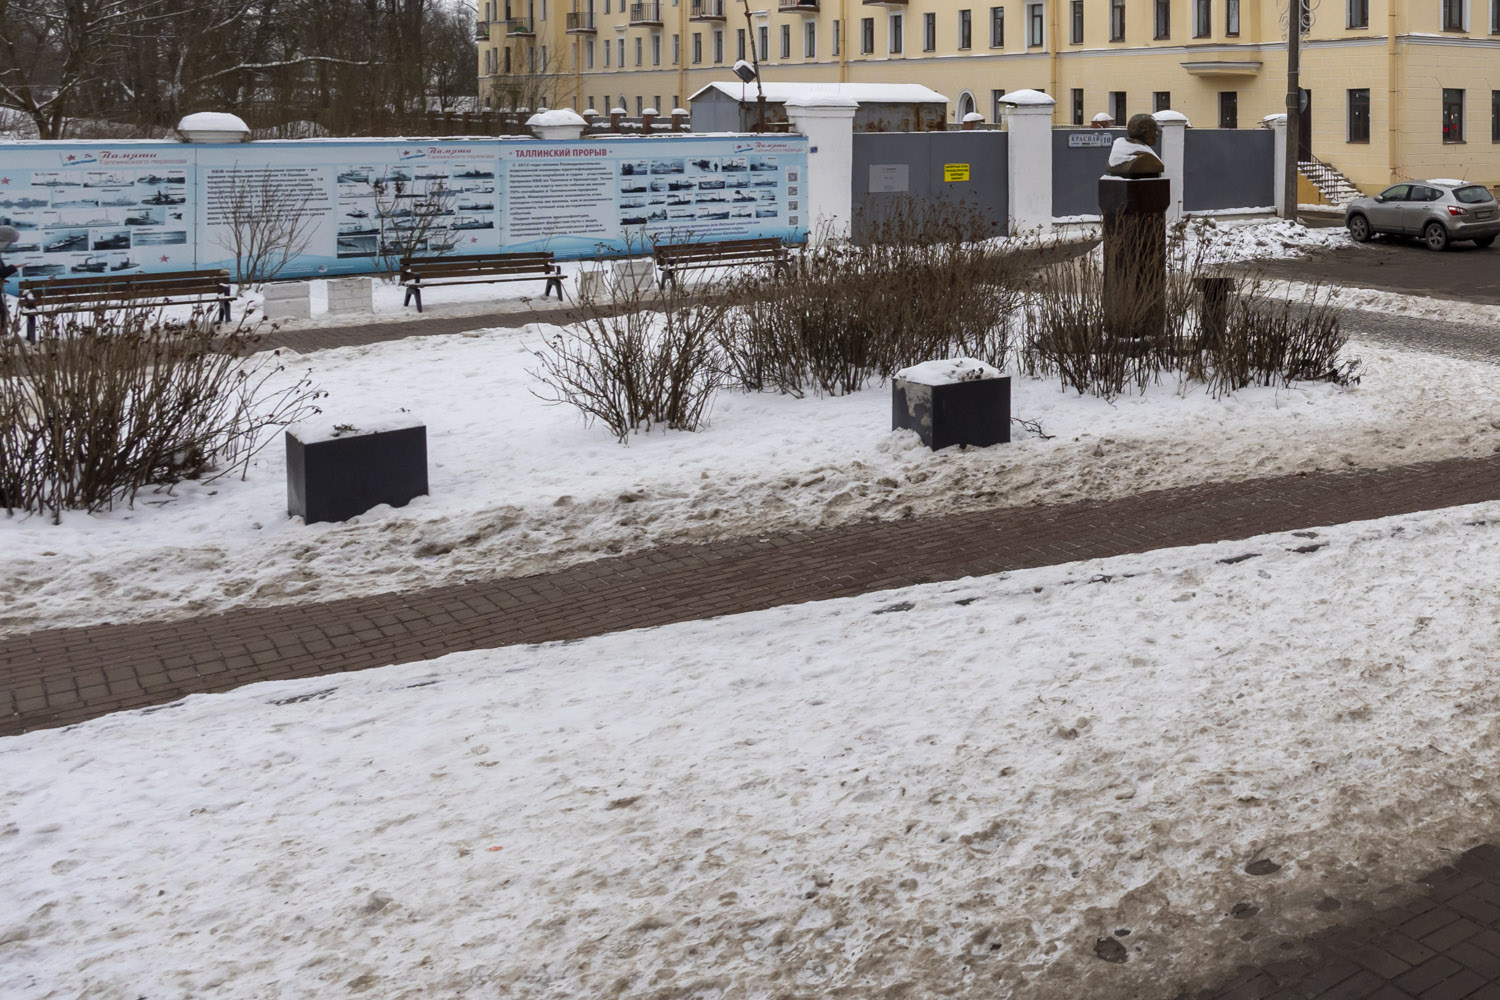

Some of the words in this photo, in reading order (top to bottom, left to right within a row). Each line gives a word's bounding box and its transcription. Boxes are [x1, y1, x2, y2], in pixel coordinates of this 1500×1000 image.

[1103, 136, 1111, 144] 10
[99, 150, 157, 160] Памяти
[515, 148, 571, 158] ТАЛЛИНСКИЙ
[572, 148, 607, 157] ПРОРЫВ
